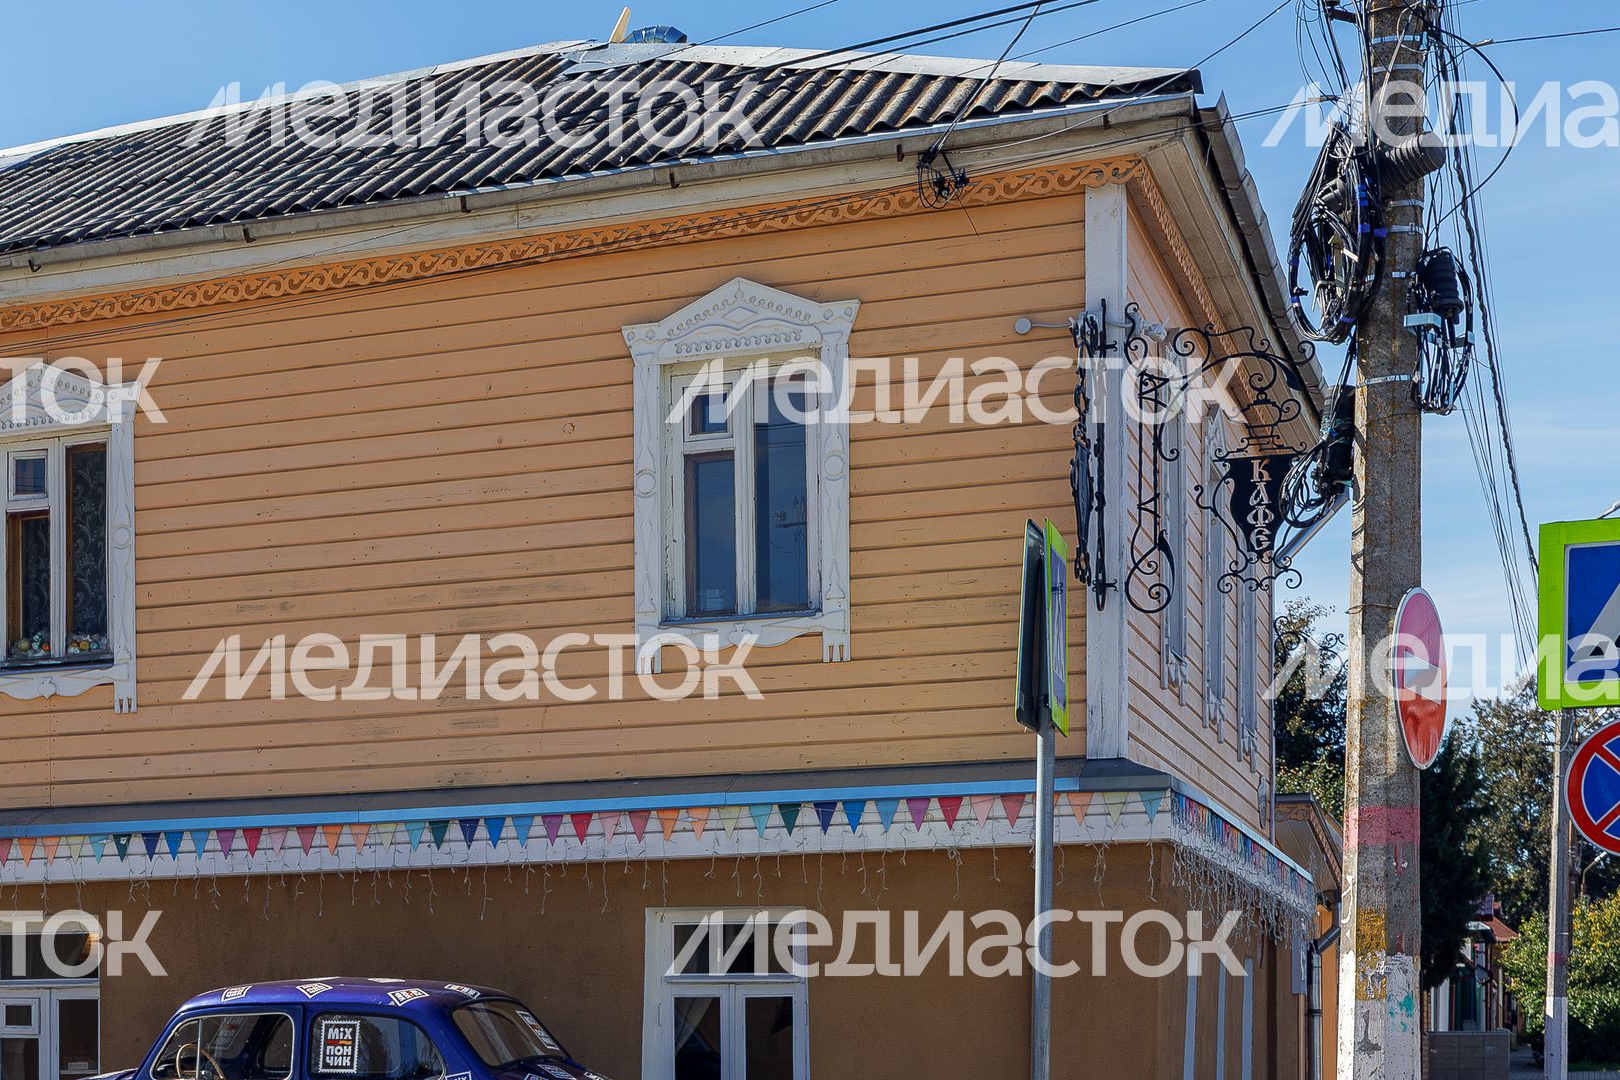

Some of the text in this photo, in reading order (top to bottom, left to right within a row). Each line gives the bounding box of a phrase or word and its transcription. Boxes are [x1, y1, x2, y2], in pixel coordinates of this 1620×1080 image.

[1249, 459, 1275, 550] КАФЕ
[327, 1027, 353, 1040] MiX
[326, 1045, 352, 1056] ПОН
[325, 1056, 351, 1066] ЧИК
